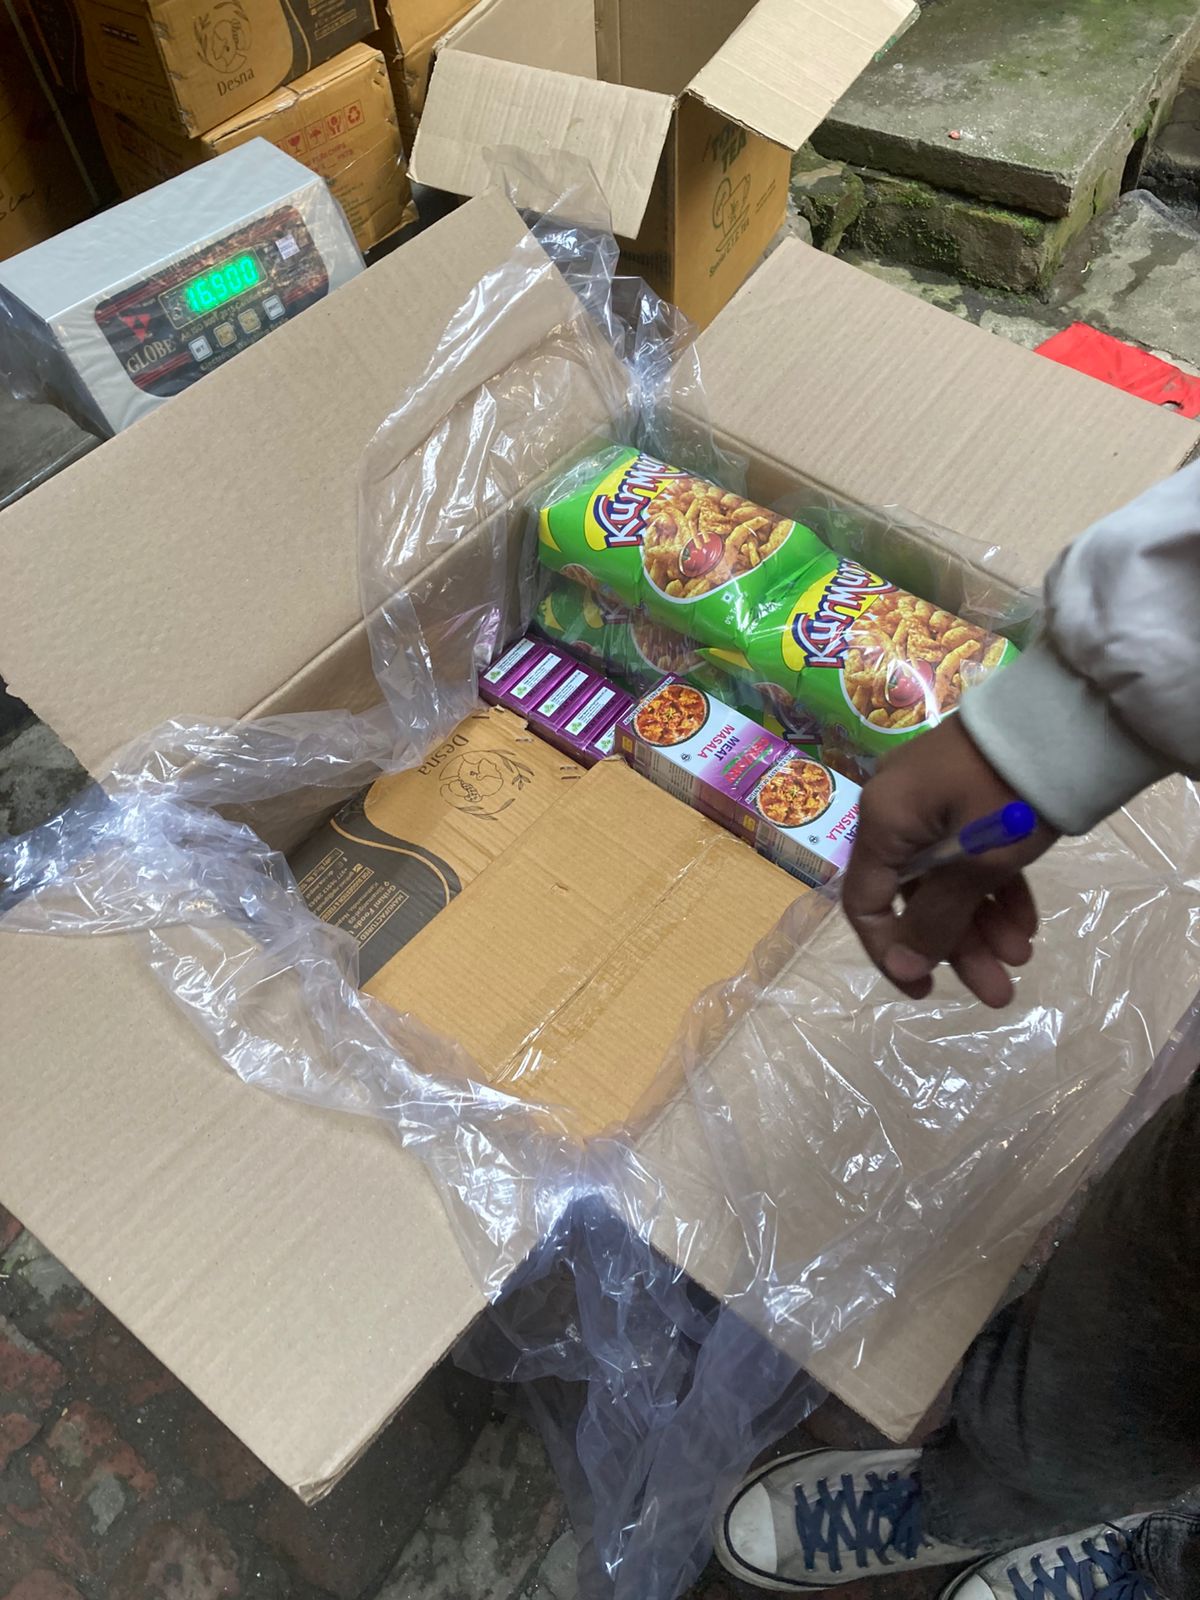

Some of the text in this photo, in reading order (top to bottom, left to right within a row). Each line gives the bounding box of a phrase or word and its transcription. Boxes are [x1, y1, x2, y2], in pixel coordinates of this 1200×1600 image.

[216, 65, 256, 97] Desna
[125, 335, 175, 374] GLOBE
[417, 732, 468, 779] Desna
[697, 722, 735, 761] MASALA
[713, 734, 740, 762] MEAT
[352, 907, 375, 931] Foods
[359, 892, 405, 942] MANUFACTURED
